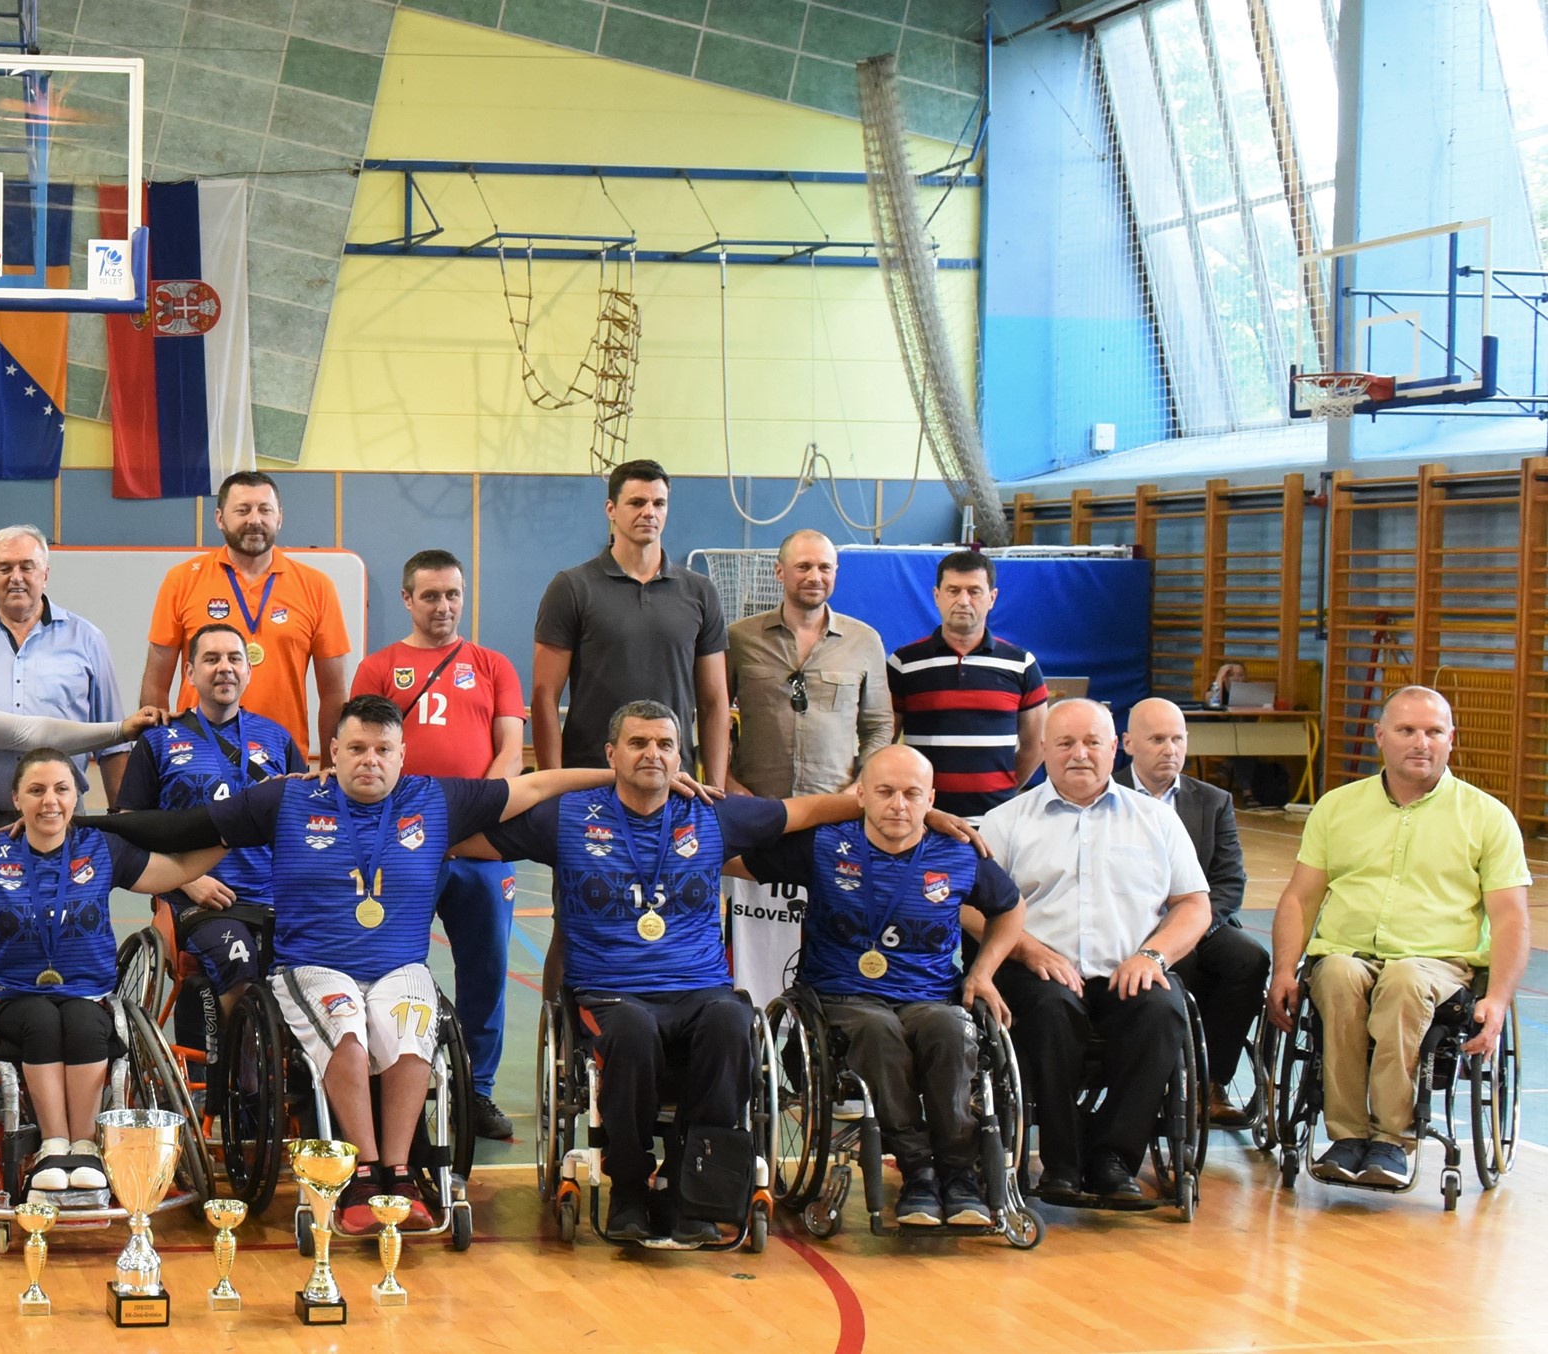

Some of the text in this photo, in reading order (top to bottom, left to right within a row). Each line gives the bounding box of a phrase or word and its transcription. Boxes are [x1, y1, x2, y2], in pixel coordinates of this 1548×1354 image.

[104, 268, 122, 277] KZS
[418, 692, 448, 726] 12
[630, 884, 666, 908] 15
[882, 925, 900, 947] 6
[228, 940, 250, 962] 4
[390, 1002, 432, 1040] 17
